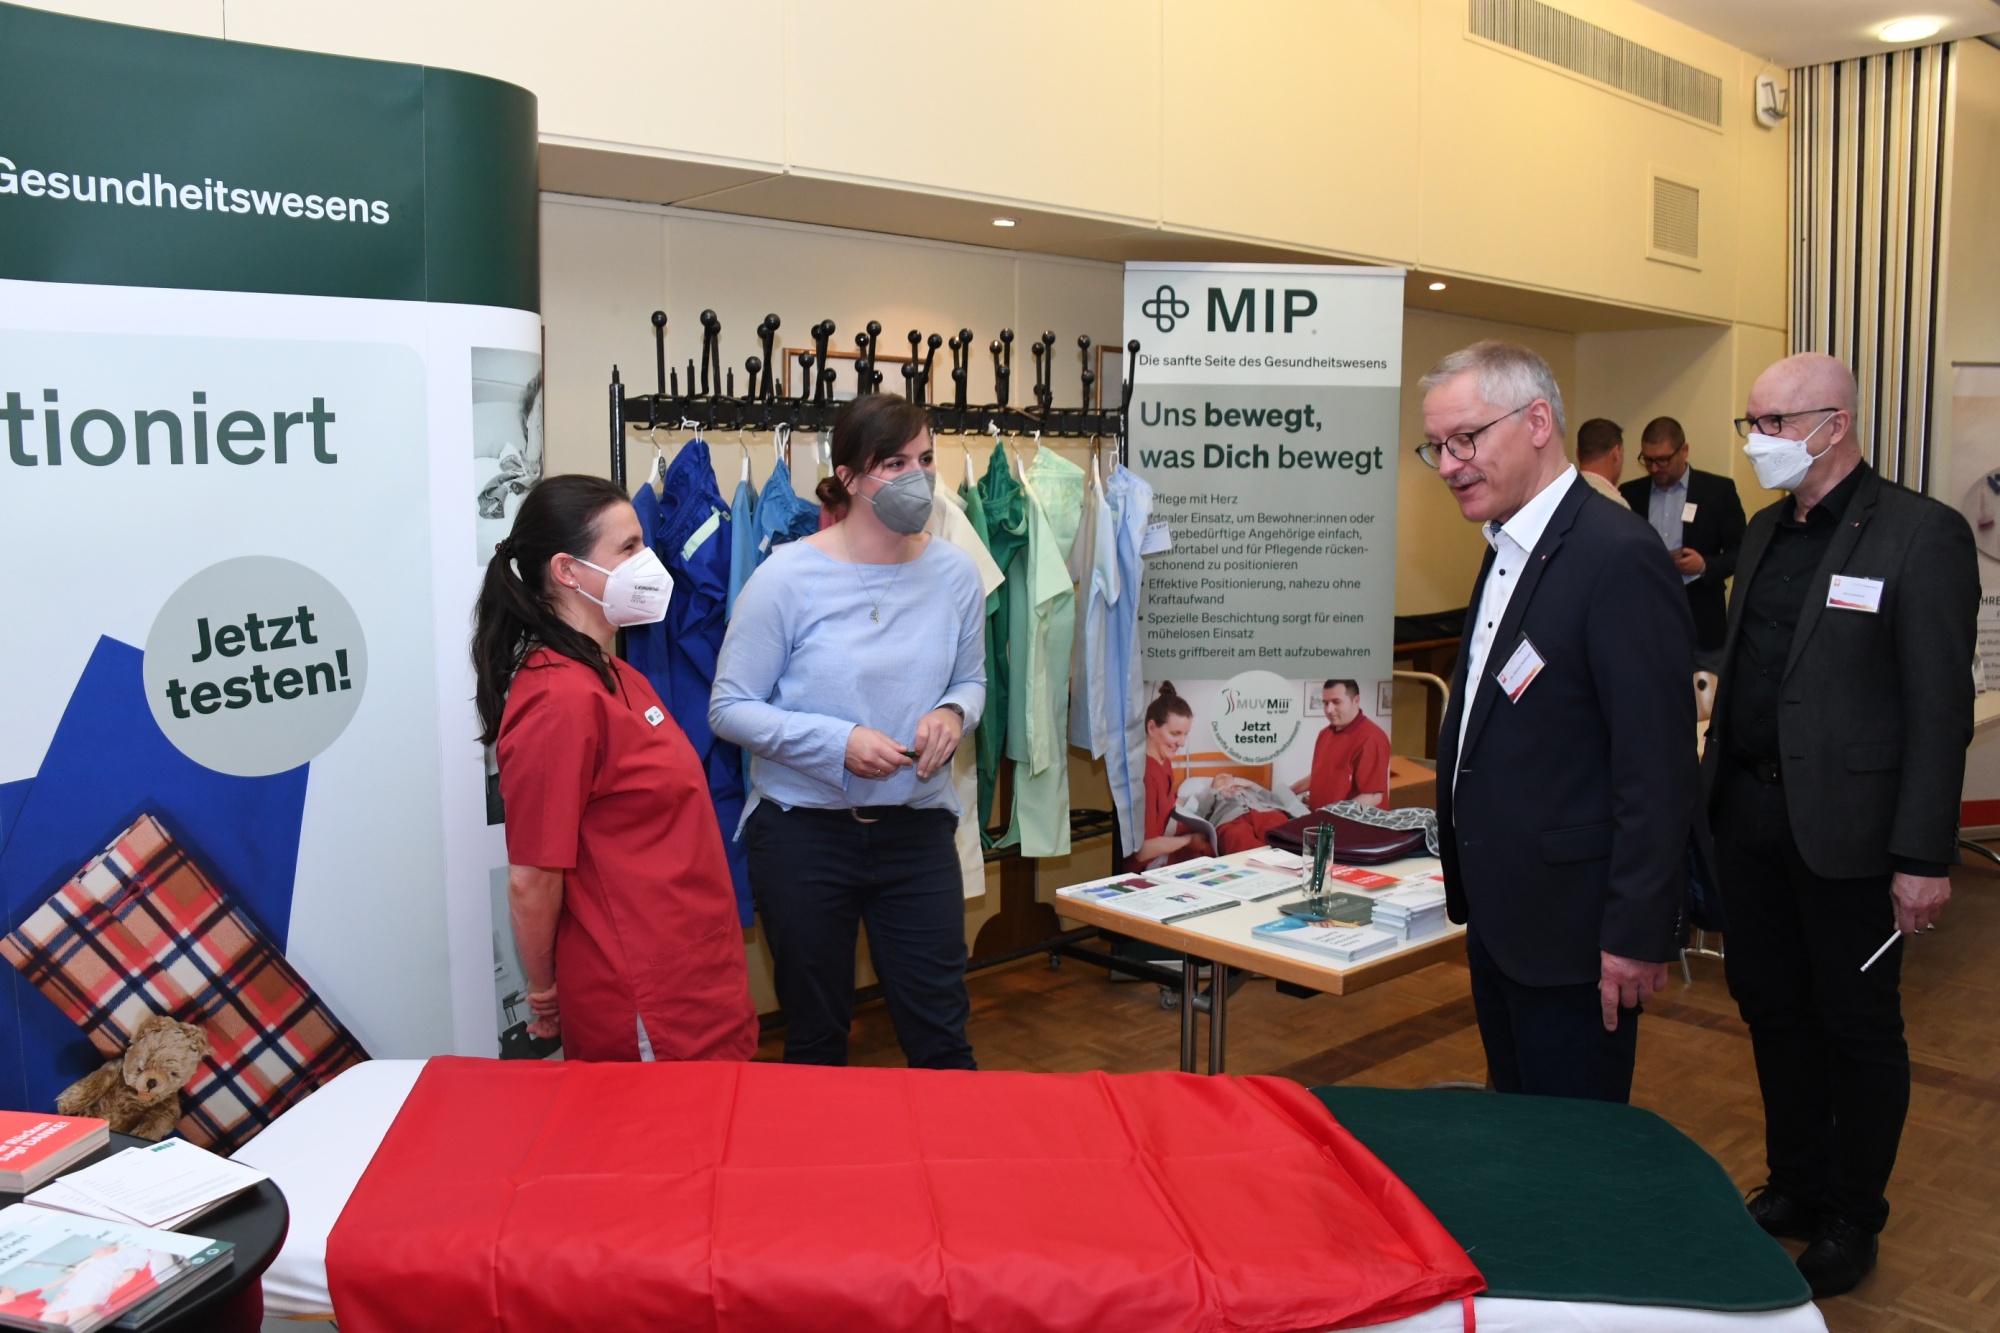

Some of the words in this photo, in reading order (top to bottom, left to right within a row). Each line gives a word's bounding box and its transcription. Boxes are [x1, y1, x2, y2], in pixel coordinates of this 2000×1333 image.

[0, 156, 390, 225] Gesundheitswesens
[1207, 287, 1318, 333] MIP
[1139, 354, 1160, 366] Die
[1163, 354, 1202, 367] sanfte
[1204, 355, 1236, 367] Seite
[1238, 355, 1261, 368] des
[1264, 355, 1387, 369] Gesundheitswesens
[1140, 401, 1197, 427] Uns
[1204, 402, 1322, 433] bewegt,
[0, 388, 338, 467] tioniert
[1139, 449, 1195, 469] was
[1203, 444, 1269, 469] Dich
[1278, 444, 1383, 475] bewegt
[1189, 493, 1207, 504] mit
[1210, 493, 1238, 504] Herz
[1191, 512, 1234, 526] Einsatz,
[1236, 515, 1254, 524] um
[1257, 512, 1347, 524] Bewohner:innen
[1349, 512, 1375, 524] oder
[1171, 528, 1246, 543] gebedürftige
[1248, 528, 1315, 543] Angehörige
[1318, 528, 1362, 541] einfach,
[1221, 544, 1243, 555] und
[1246, 543, 1262, 555] für
[1264, 544, 1322, 558] Pflegende
[1325, 544, 1369, 555] rücken-
[1149, 559, 1205, 571] schonend
[1207, 561, 1221, 570] zu
[1224, 559, 1298, 573] positionieren
[1148, 578, 1198, 590] Effektive
[1201, 578, 1286, 592] Positionierung,
[1289, 578, 1329, 590] nahezu
[1332, 578, 1361, 590] ohne
[1148, 593, 1225, 605] Kraftaufwand
[1981, 595, 2000, 606] HRE
[1147, 612, 1199, 626] Spezielle
[1201, 612, 1280, 626] Beschichtung
[1282, 613, 1311, 627] sorgt
[1314, 612, 1330, 624] für
[1332, 613, 1364, 624] einen
[191, 605, 318, 663] Jetzt
[1147, 627, 1210, 640] mühelosen
[1213, 628, 1254, 640] Einsatz
[1147, 646, 1177, 658] Stets
[1179, 646, 1236, 661] griffbereit
[1238, 649, 1256, 658] am
[1258, 646, 1282, 658] Bett
[1285, 647, 1371, 659] aufzubewahren
[165, 648, 352, 719] testen!
[1242, 721, 1271, 731] Jetzt
[1235, 733, 1277, 743] testen!
